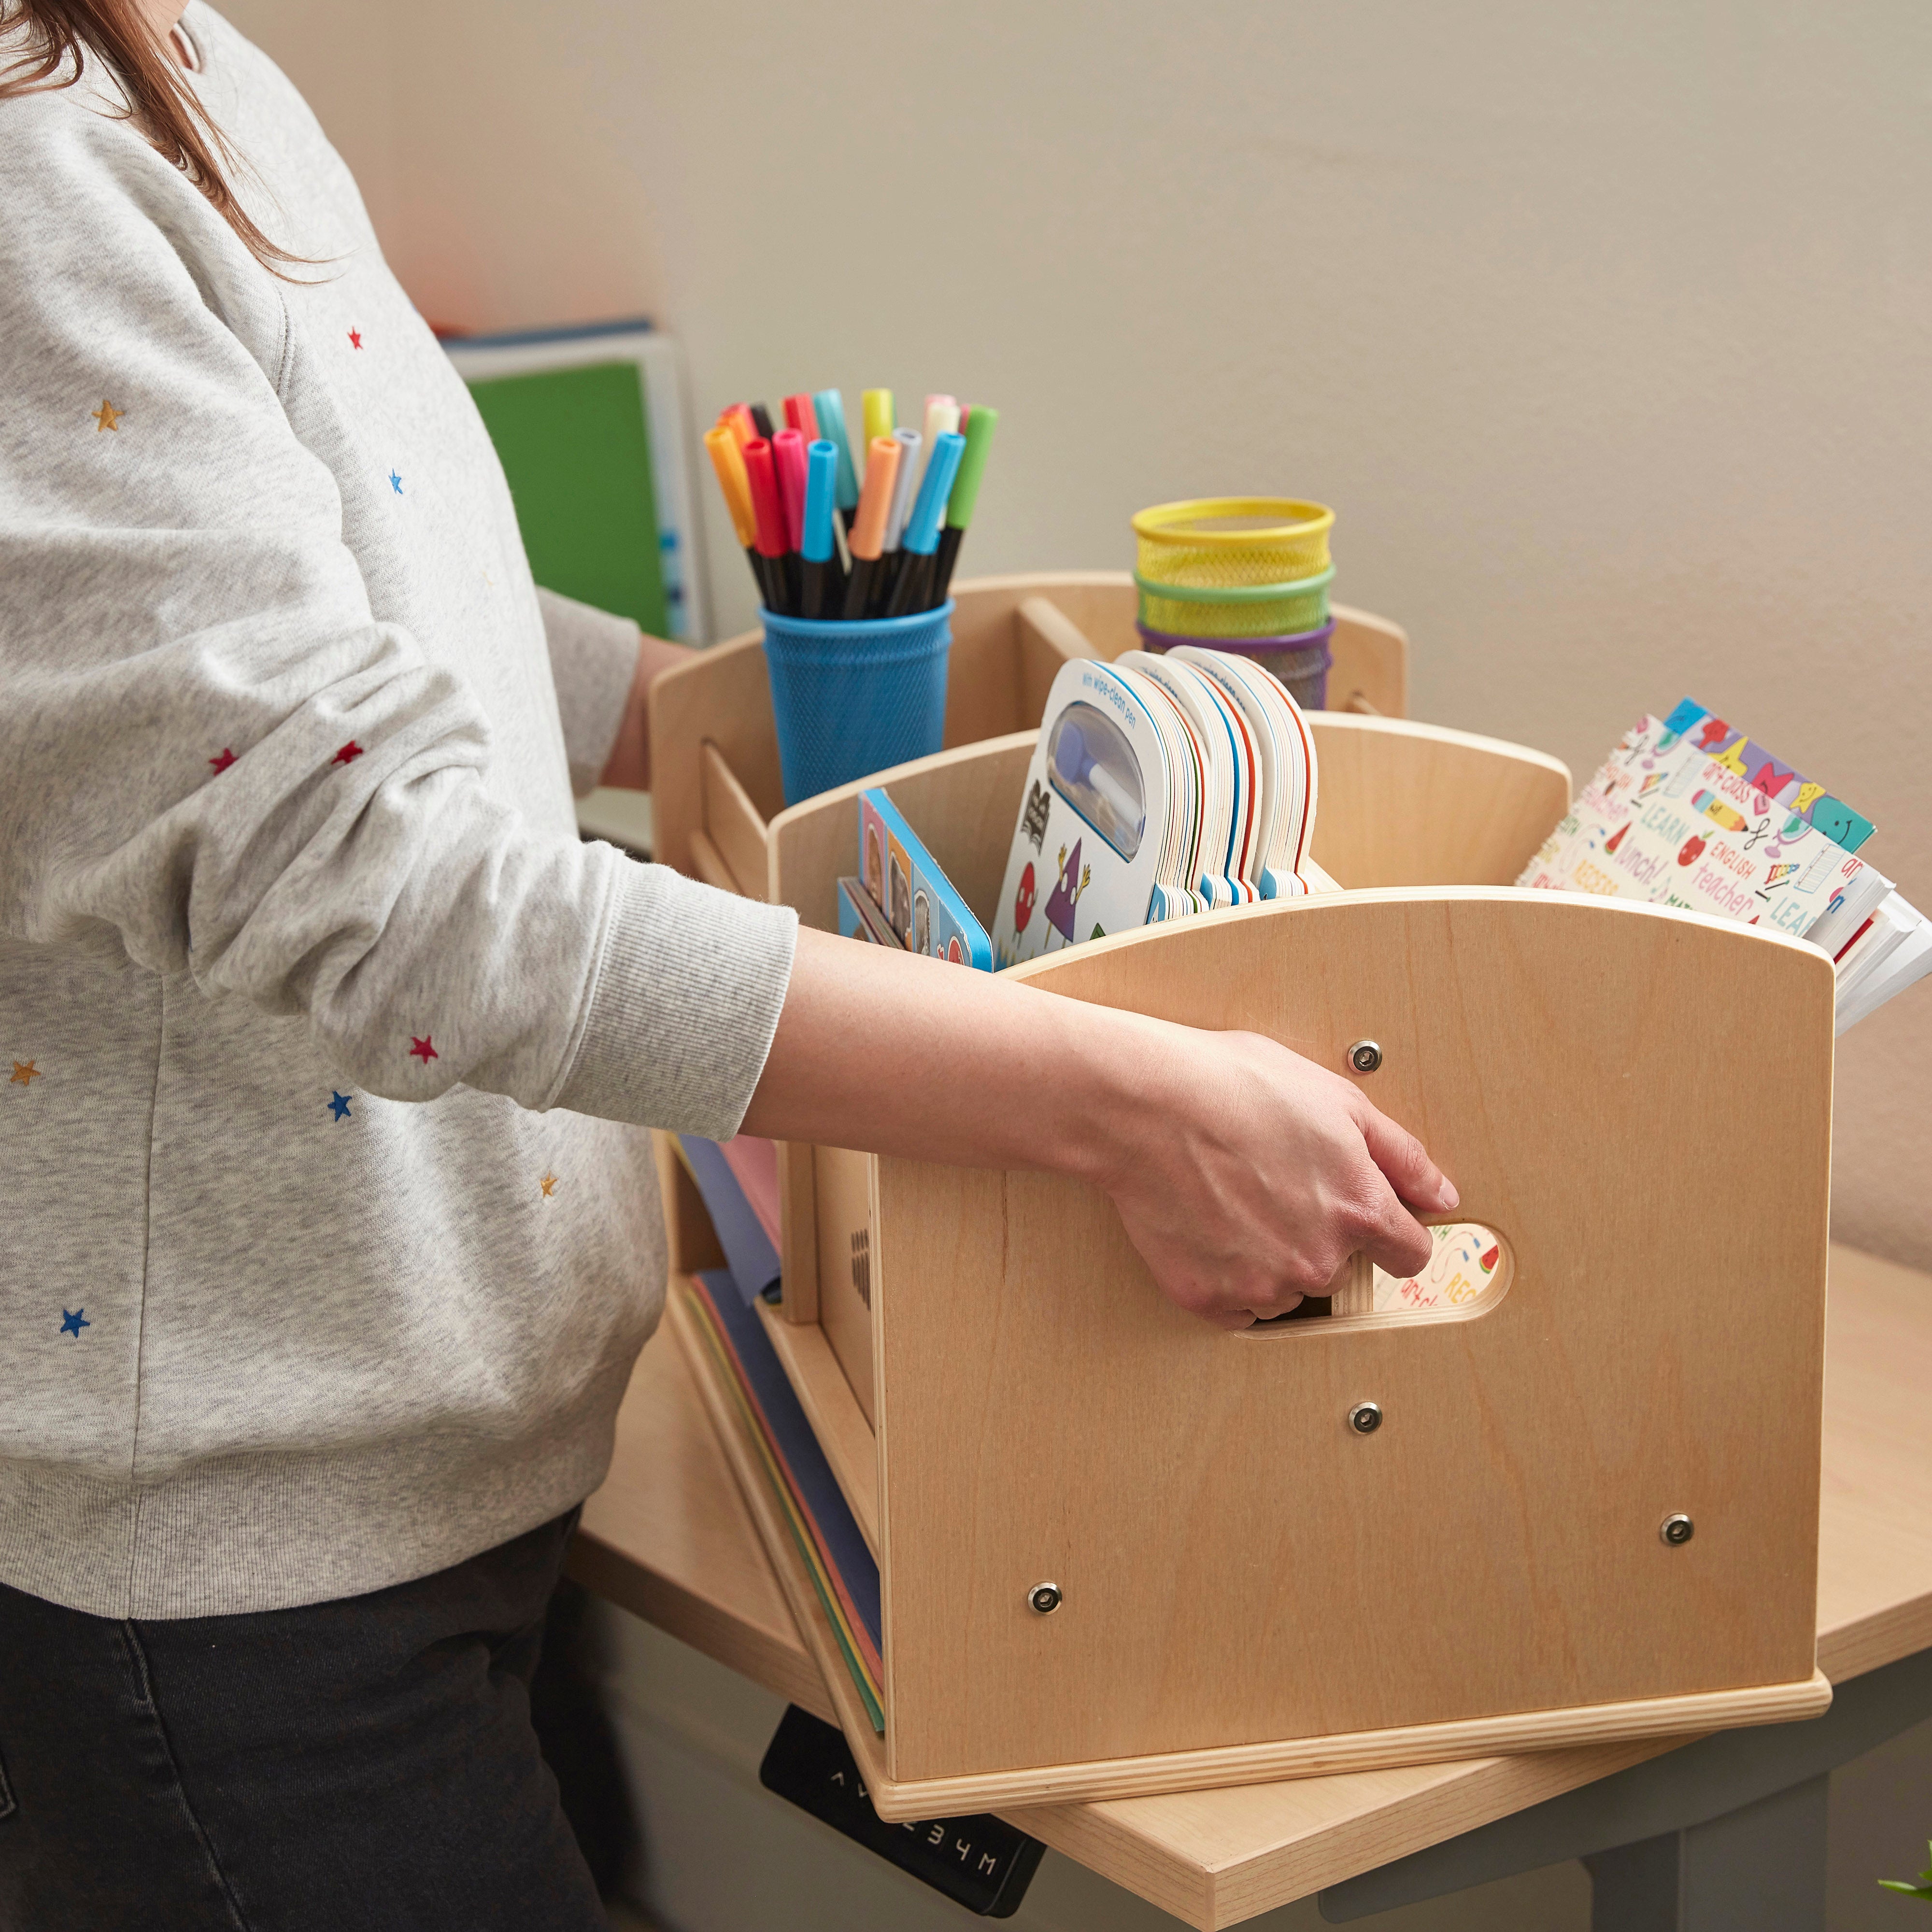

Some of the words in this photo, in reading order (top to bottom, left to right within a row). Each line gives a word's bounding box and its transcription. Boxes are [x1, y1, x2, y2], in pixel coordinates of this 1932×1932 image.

[1094, 675, 1125, 713] wipe-clean
[1125, 708, 1136, 729] pen
[1640, 802, 1691, 845] LEARN
[1710, 840, 1757, 880] ENGLISH
[1692, 862, 1754, 915] teacher
[927, 1824, 945, 1845] 3
[956, 1838, 971, 1861] 4
[978, 1852, 997, 1875] M
